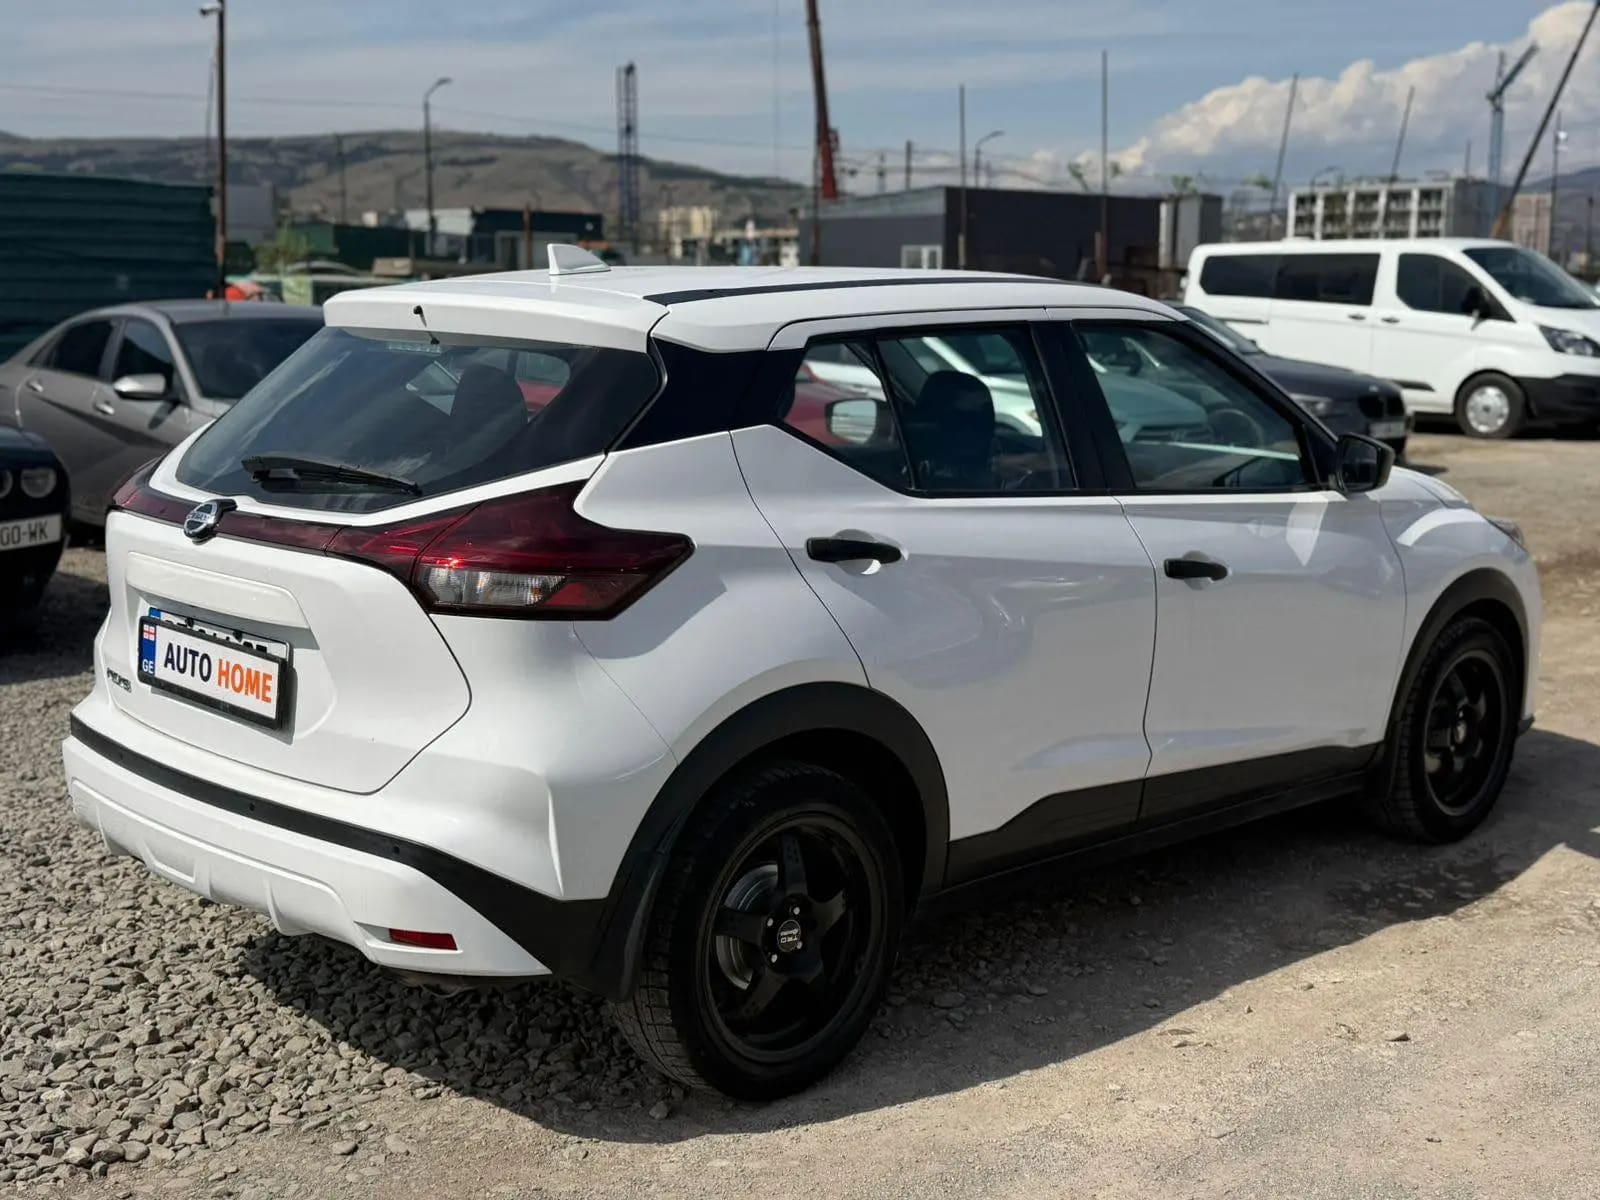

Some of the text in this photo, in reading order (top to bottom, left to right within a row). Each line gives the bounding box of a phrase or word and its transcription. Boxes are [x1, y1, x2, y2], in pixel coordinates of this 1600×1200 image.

[142, 658, 154, 674] GE
[163, 642, 273, 703] AUTO HOME
